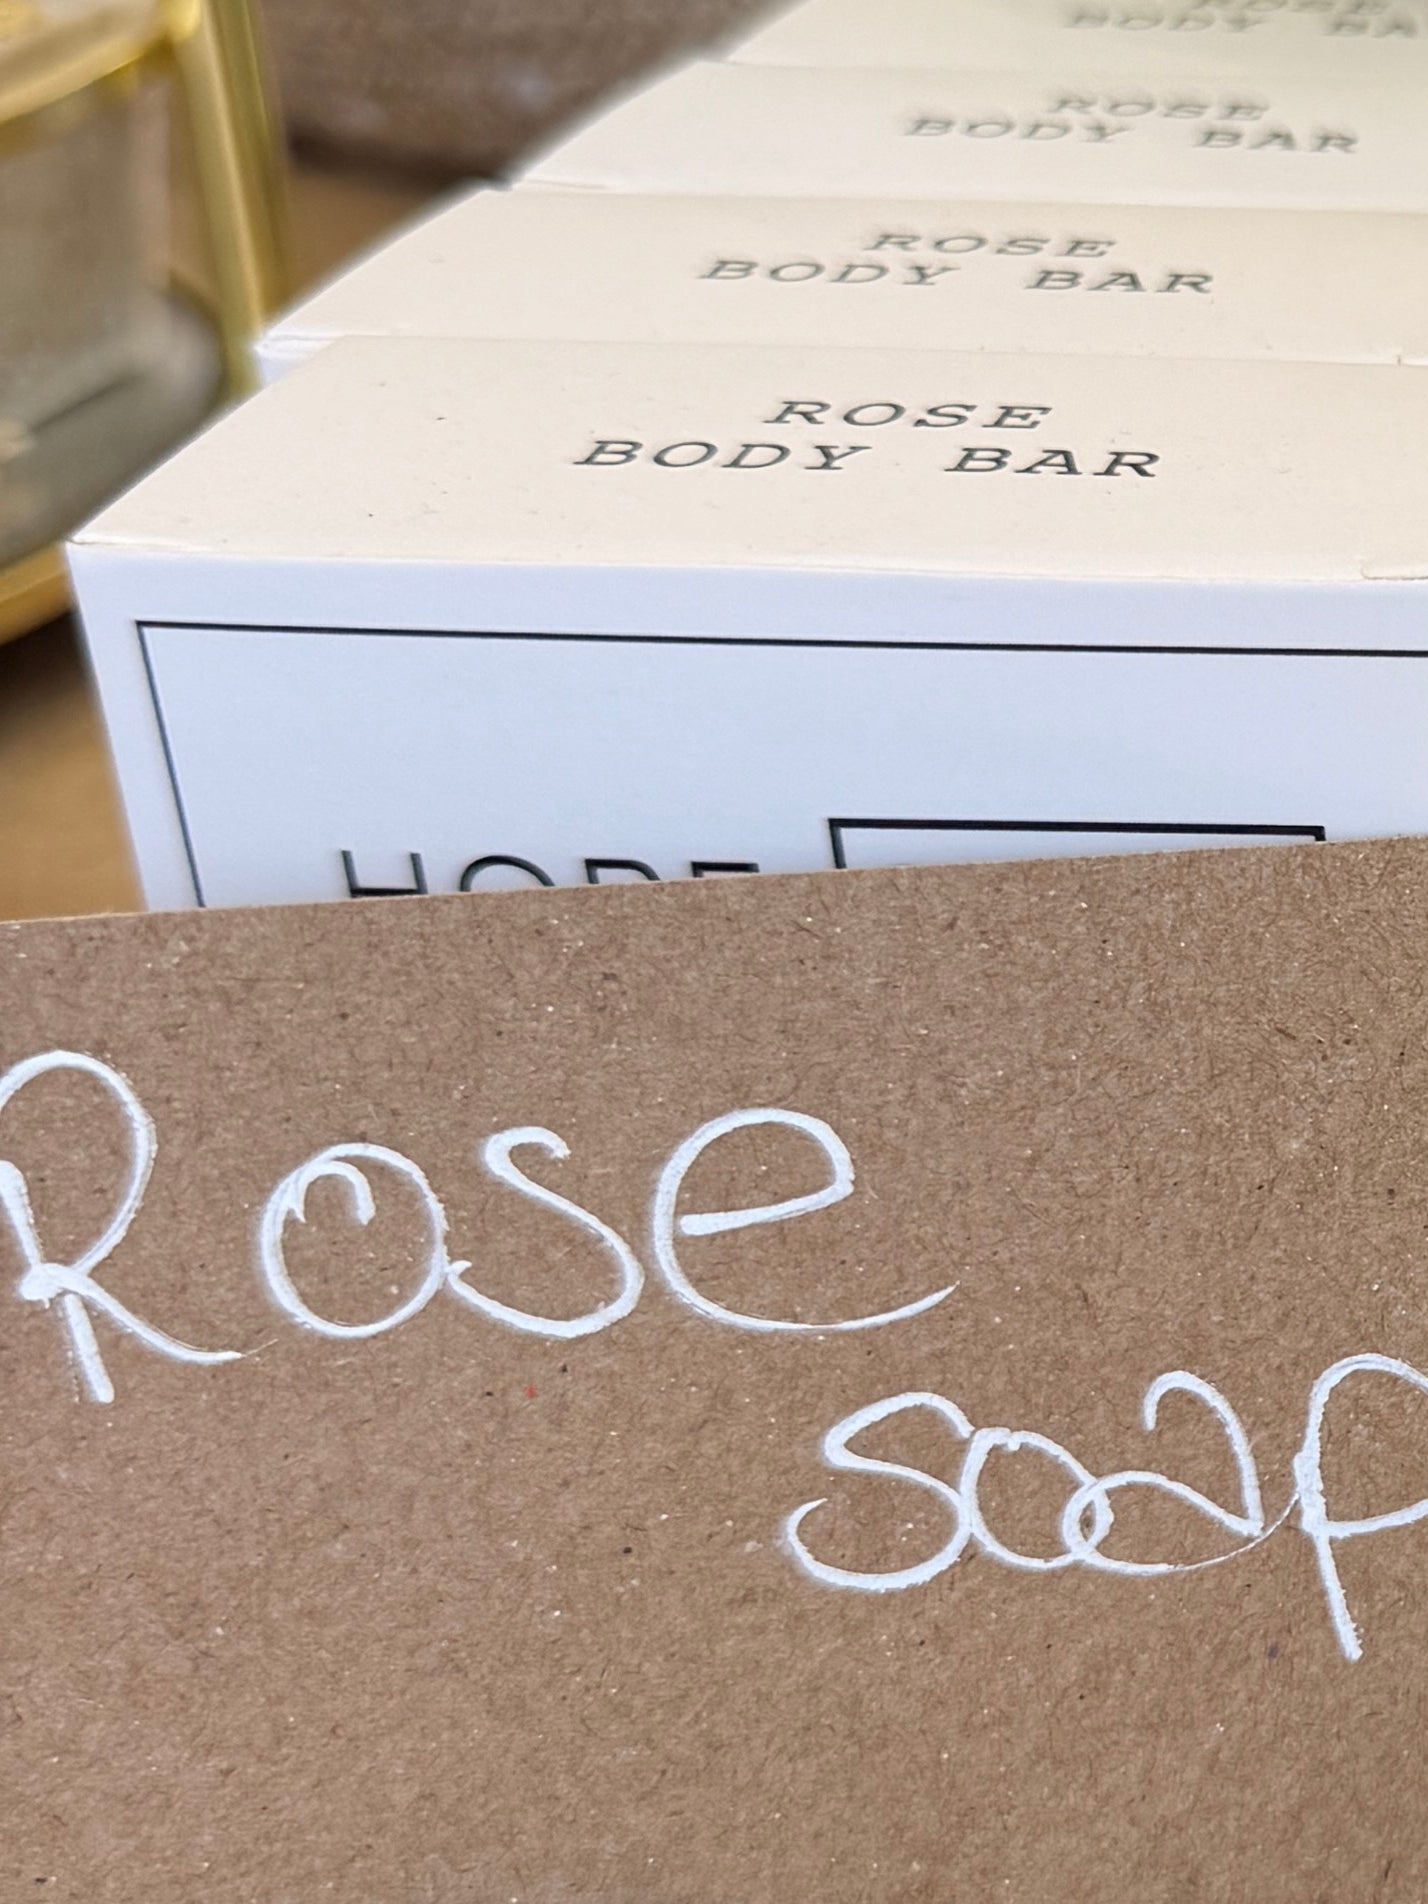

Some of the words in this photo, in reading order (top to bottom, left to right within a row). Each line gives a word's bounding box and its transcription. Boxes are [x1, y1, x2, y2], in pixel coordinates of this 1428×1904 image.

[1066, 7, 1270, 32] BODY
[1046, 95, 1270, 122] ROSE
[904, 116, 1134, 143] BODY
[1194, 127, 1360, 154] BAR
[862, 232, 1118, 258] ROSE
[698, 259, 962, 286] BODY
[1024, 269, 1216, 295] BAR
[761, 400, 1054, 431] ROSE
[571, 439, 872, 472] BODY
[943, 446, 1161, 479] BAR
[0, 1049, 962, 1405] Rose
